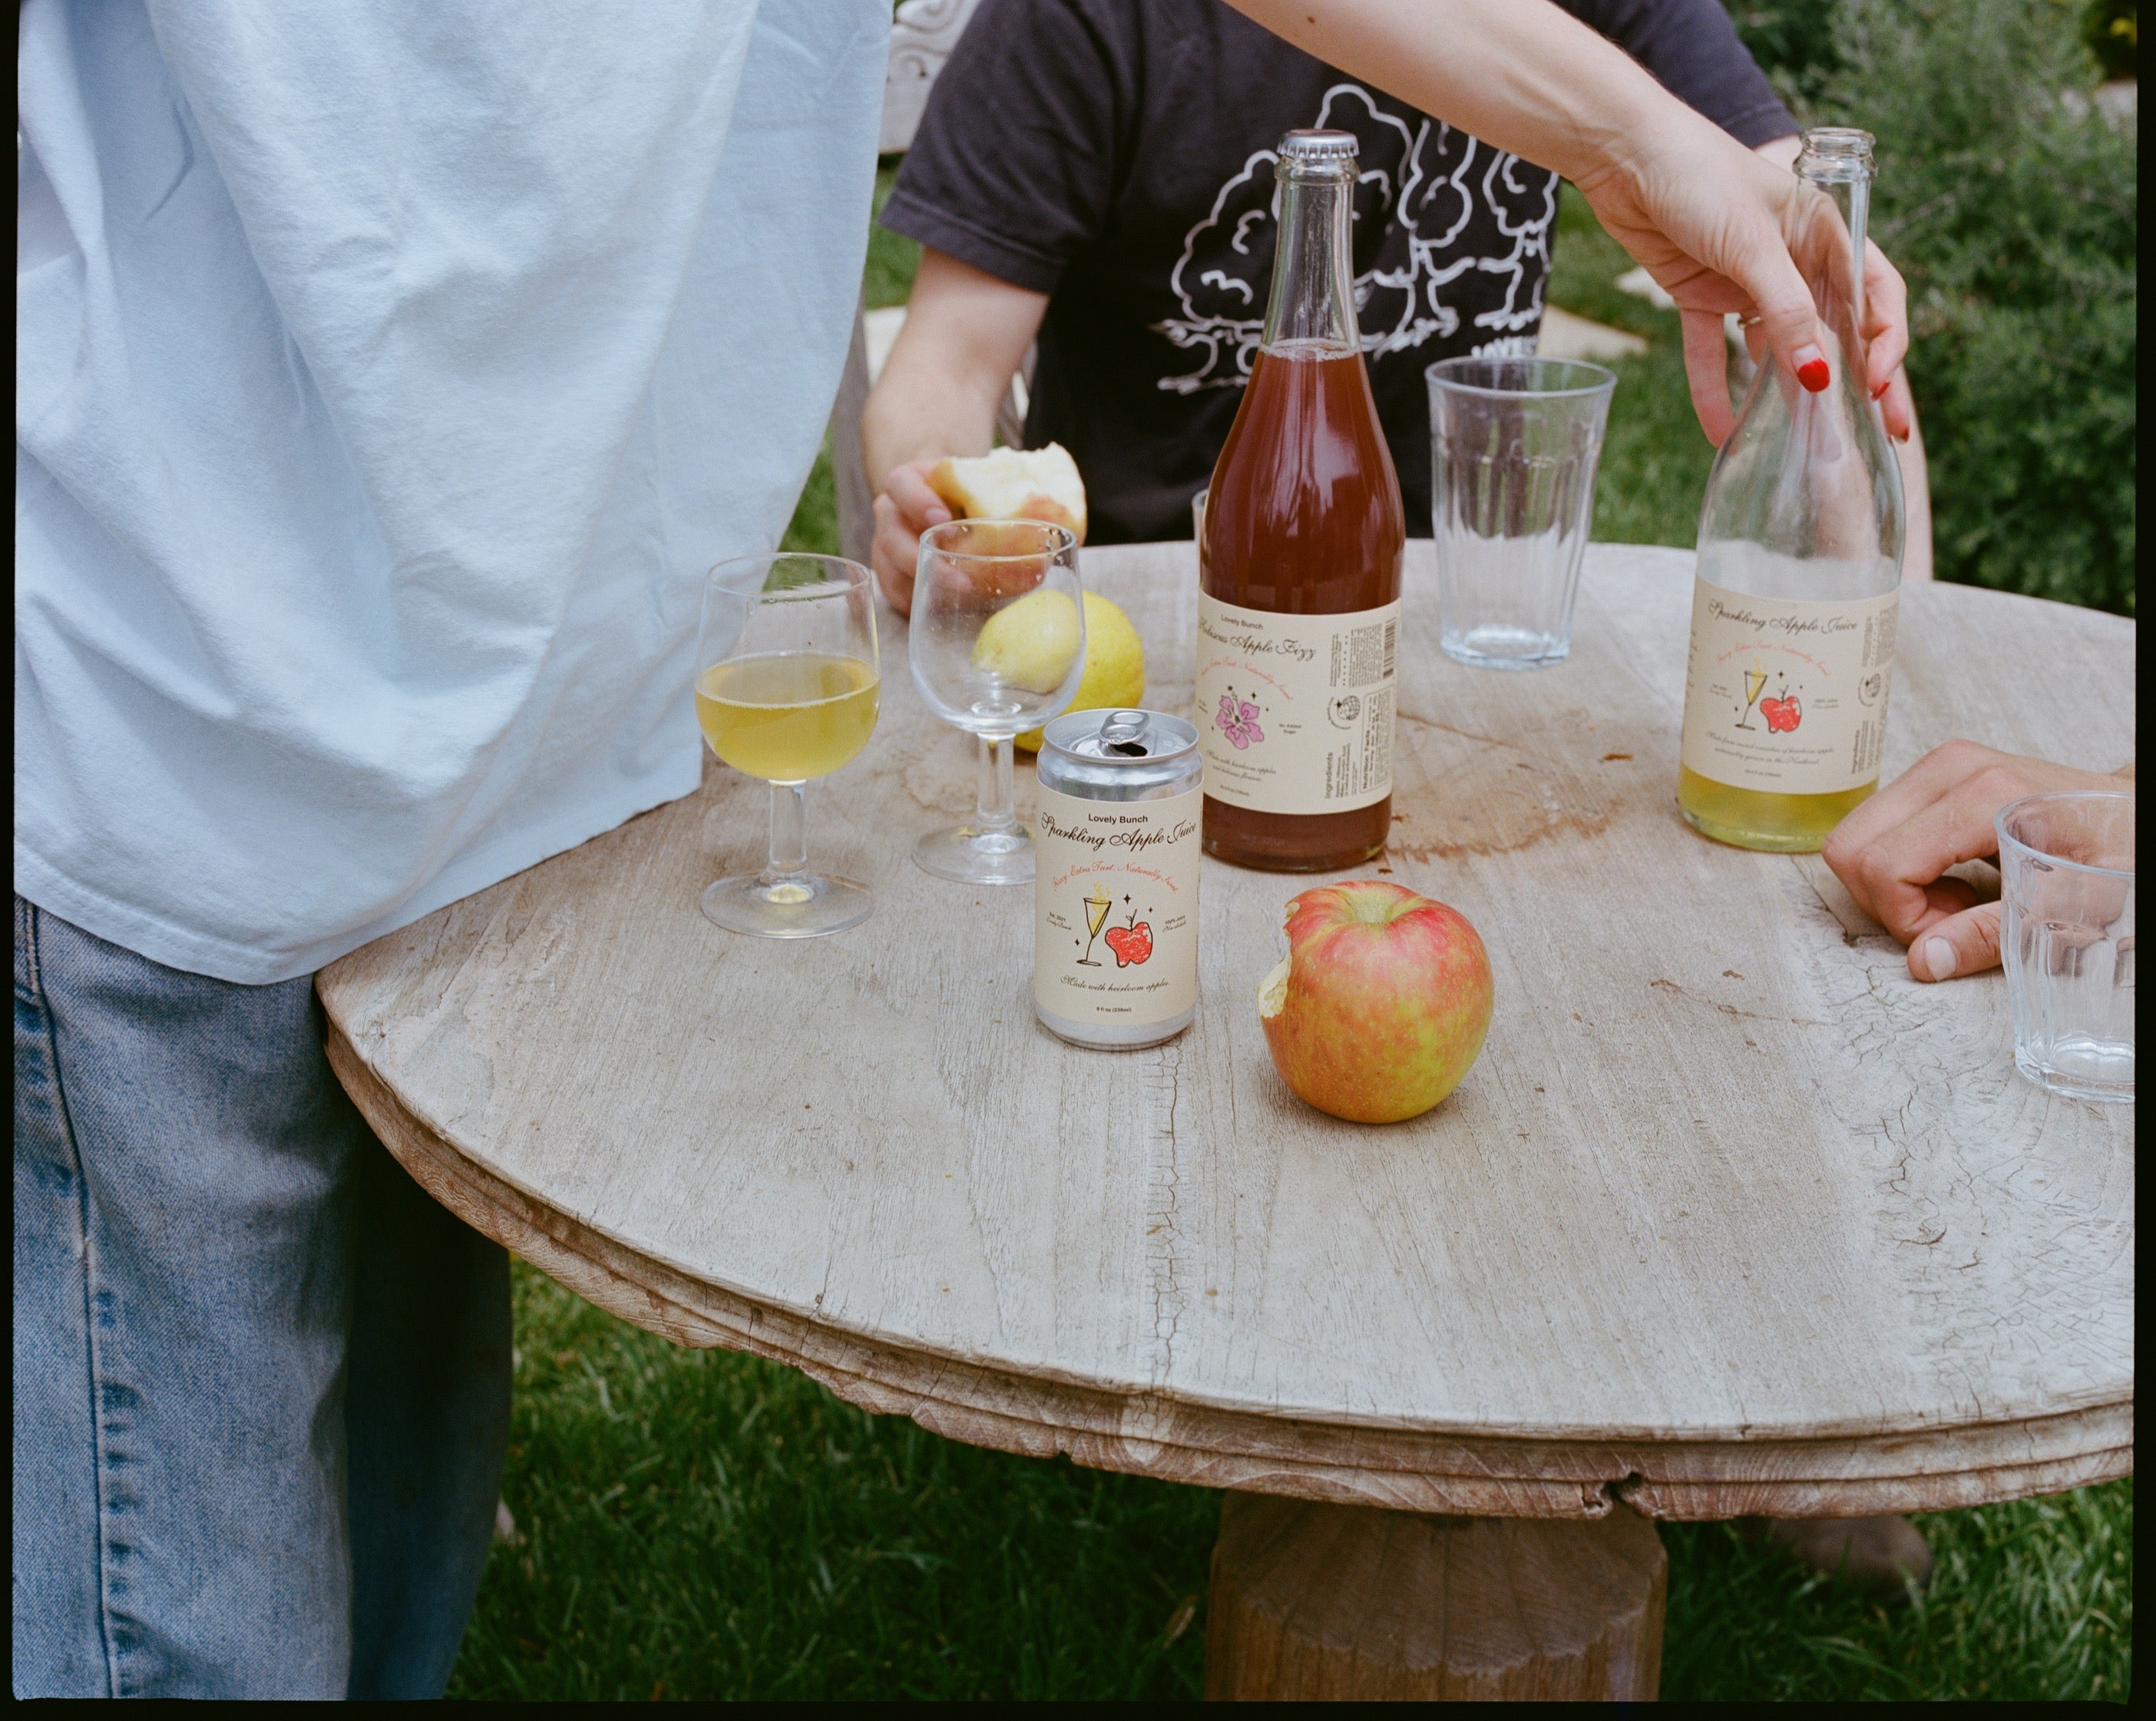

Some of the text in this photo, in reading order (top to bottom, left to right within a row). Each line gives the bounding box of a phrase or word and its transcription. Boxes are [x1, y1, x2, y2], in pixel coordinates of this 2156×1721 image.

[1221, 614, 1263, 630] Lovely Bunch
[1708, 599, 1858, 635] Sparkling Apple Juice
[1229, 635, 1273, 656] Apple
[1275, 639, 1316, 661] Fizz
[1324, 752, 1334, 799] Ingredients
[1088, 813, 1149, 825] Lovely Bunch
[1041, 812, 1106, 852] Sparkling
[1109, 828, 1164, 852] Apple
[1166, 819, 1196, 844] Juice
[1070, 864, 1090, 877] Extra
[1117, 862, 1162, 881] Naturally
[1060, 975, 1087, 989] Made
[1088, 983, 1106, 991] with
[1107, 983, 1144, 993] heirloom
